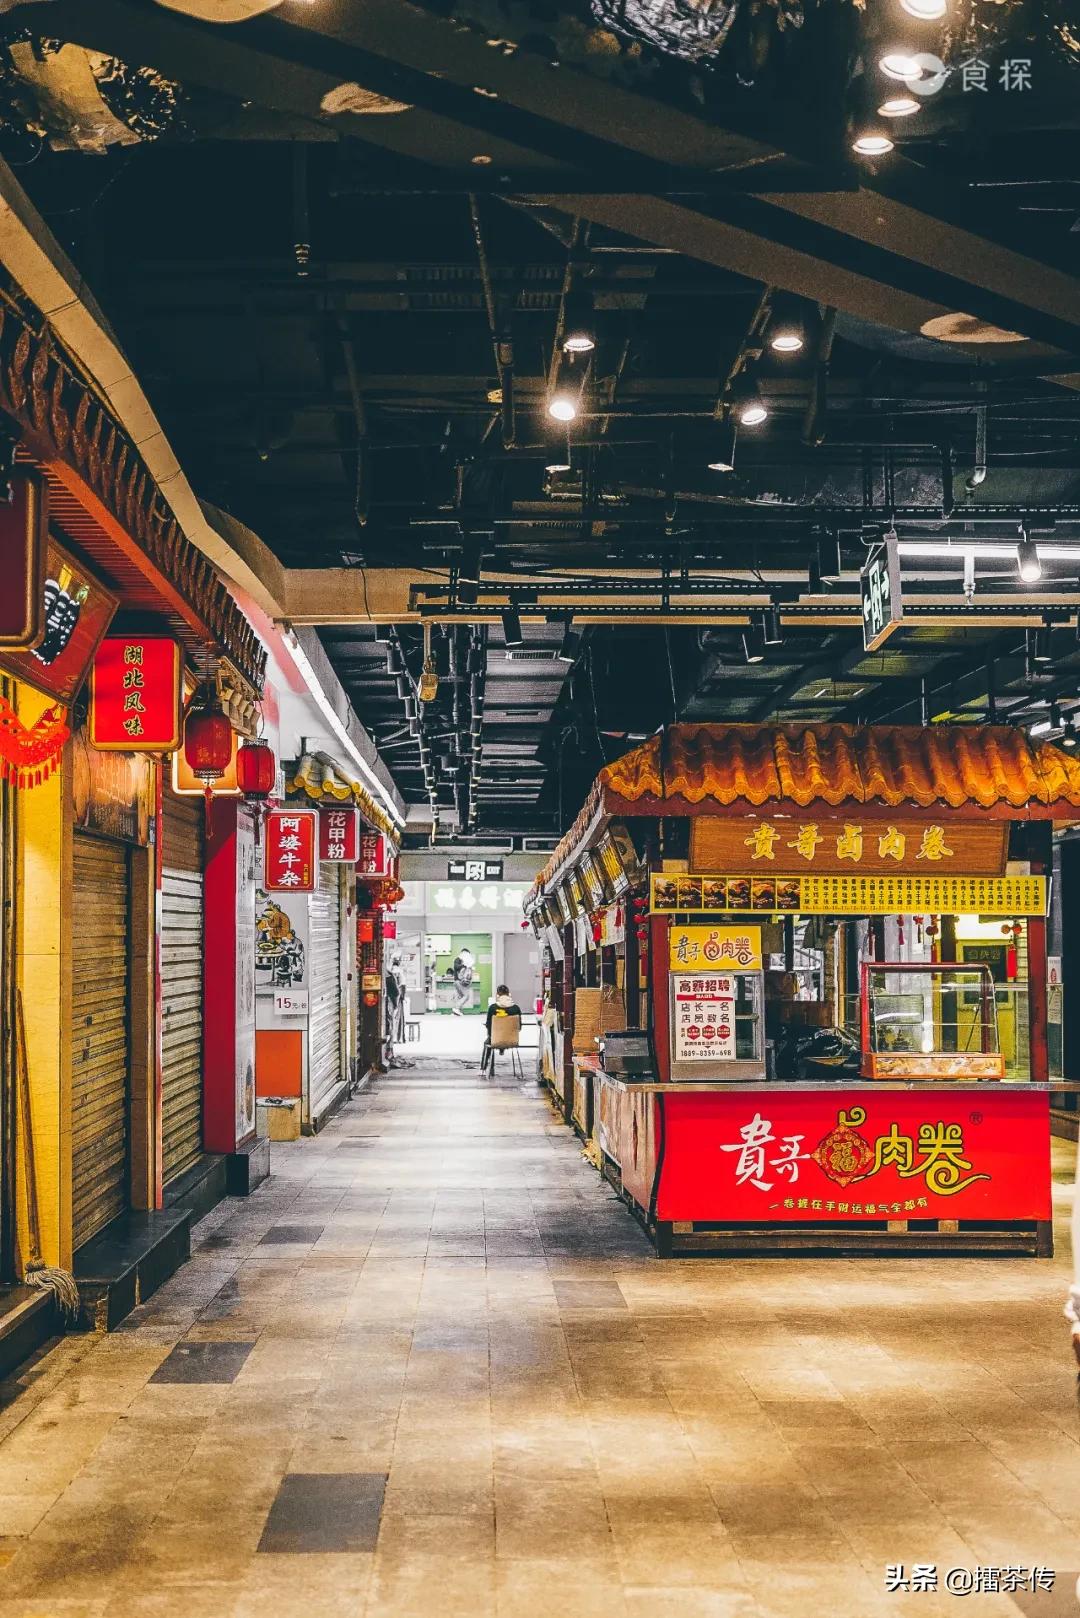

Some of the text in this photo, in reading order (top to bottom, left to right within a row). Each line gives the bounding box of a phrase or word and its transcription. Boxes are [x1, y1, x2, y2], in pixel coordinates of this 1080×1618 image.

[123, 645, 146, 736] 湖北风味
[278, 817, 302, 887] 阿婆牛杂
[328, 811, 346, 859] 花甲粉
[362, 836, 377, 873] 花甲粉
[679, 979, 730, 992] 高薪招聘
